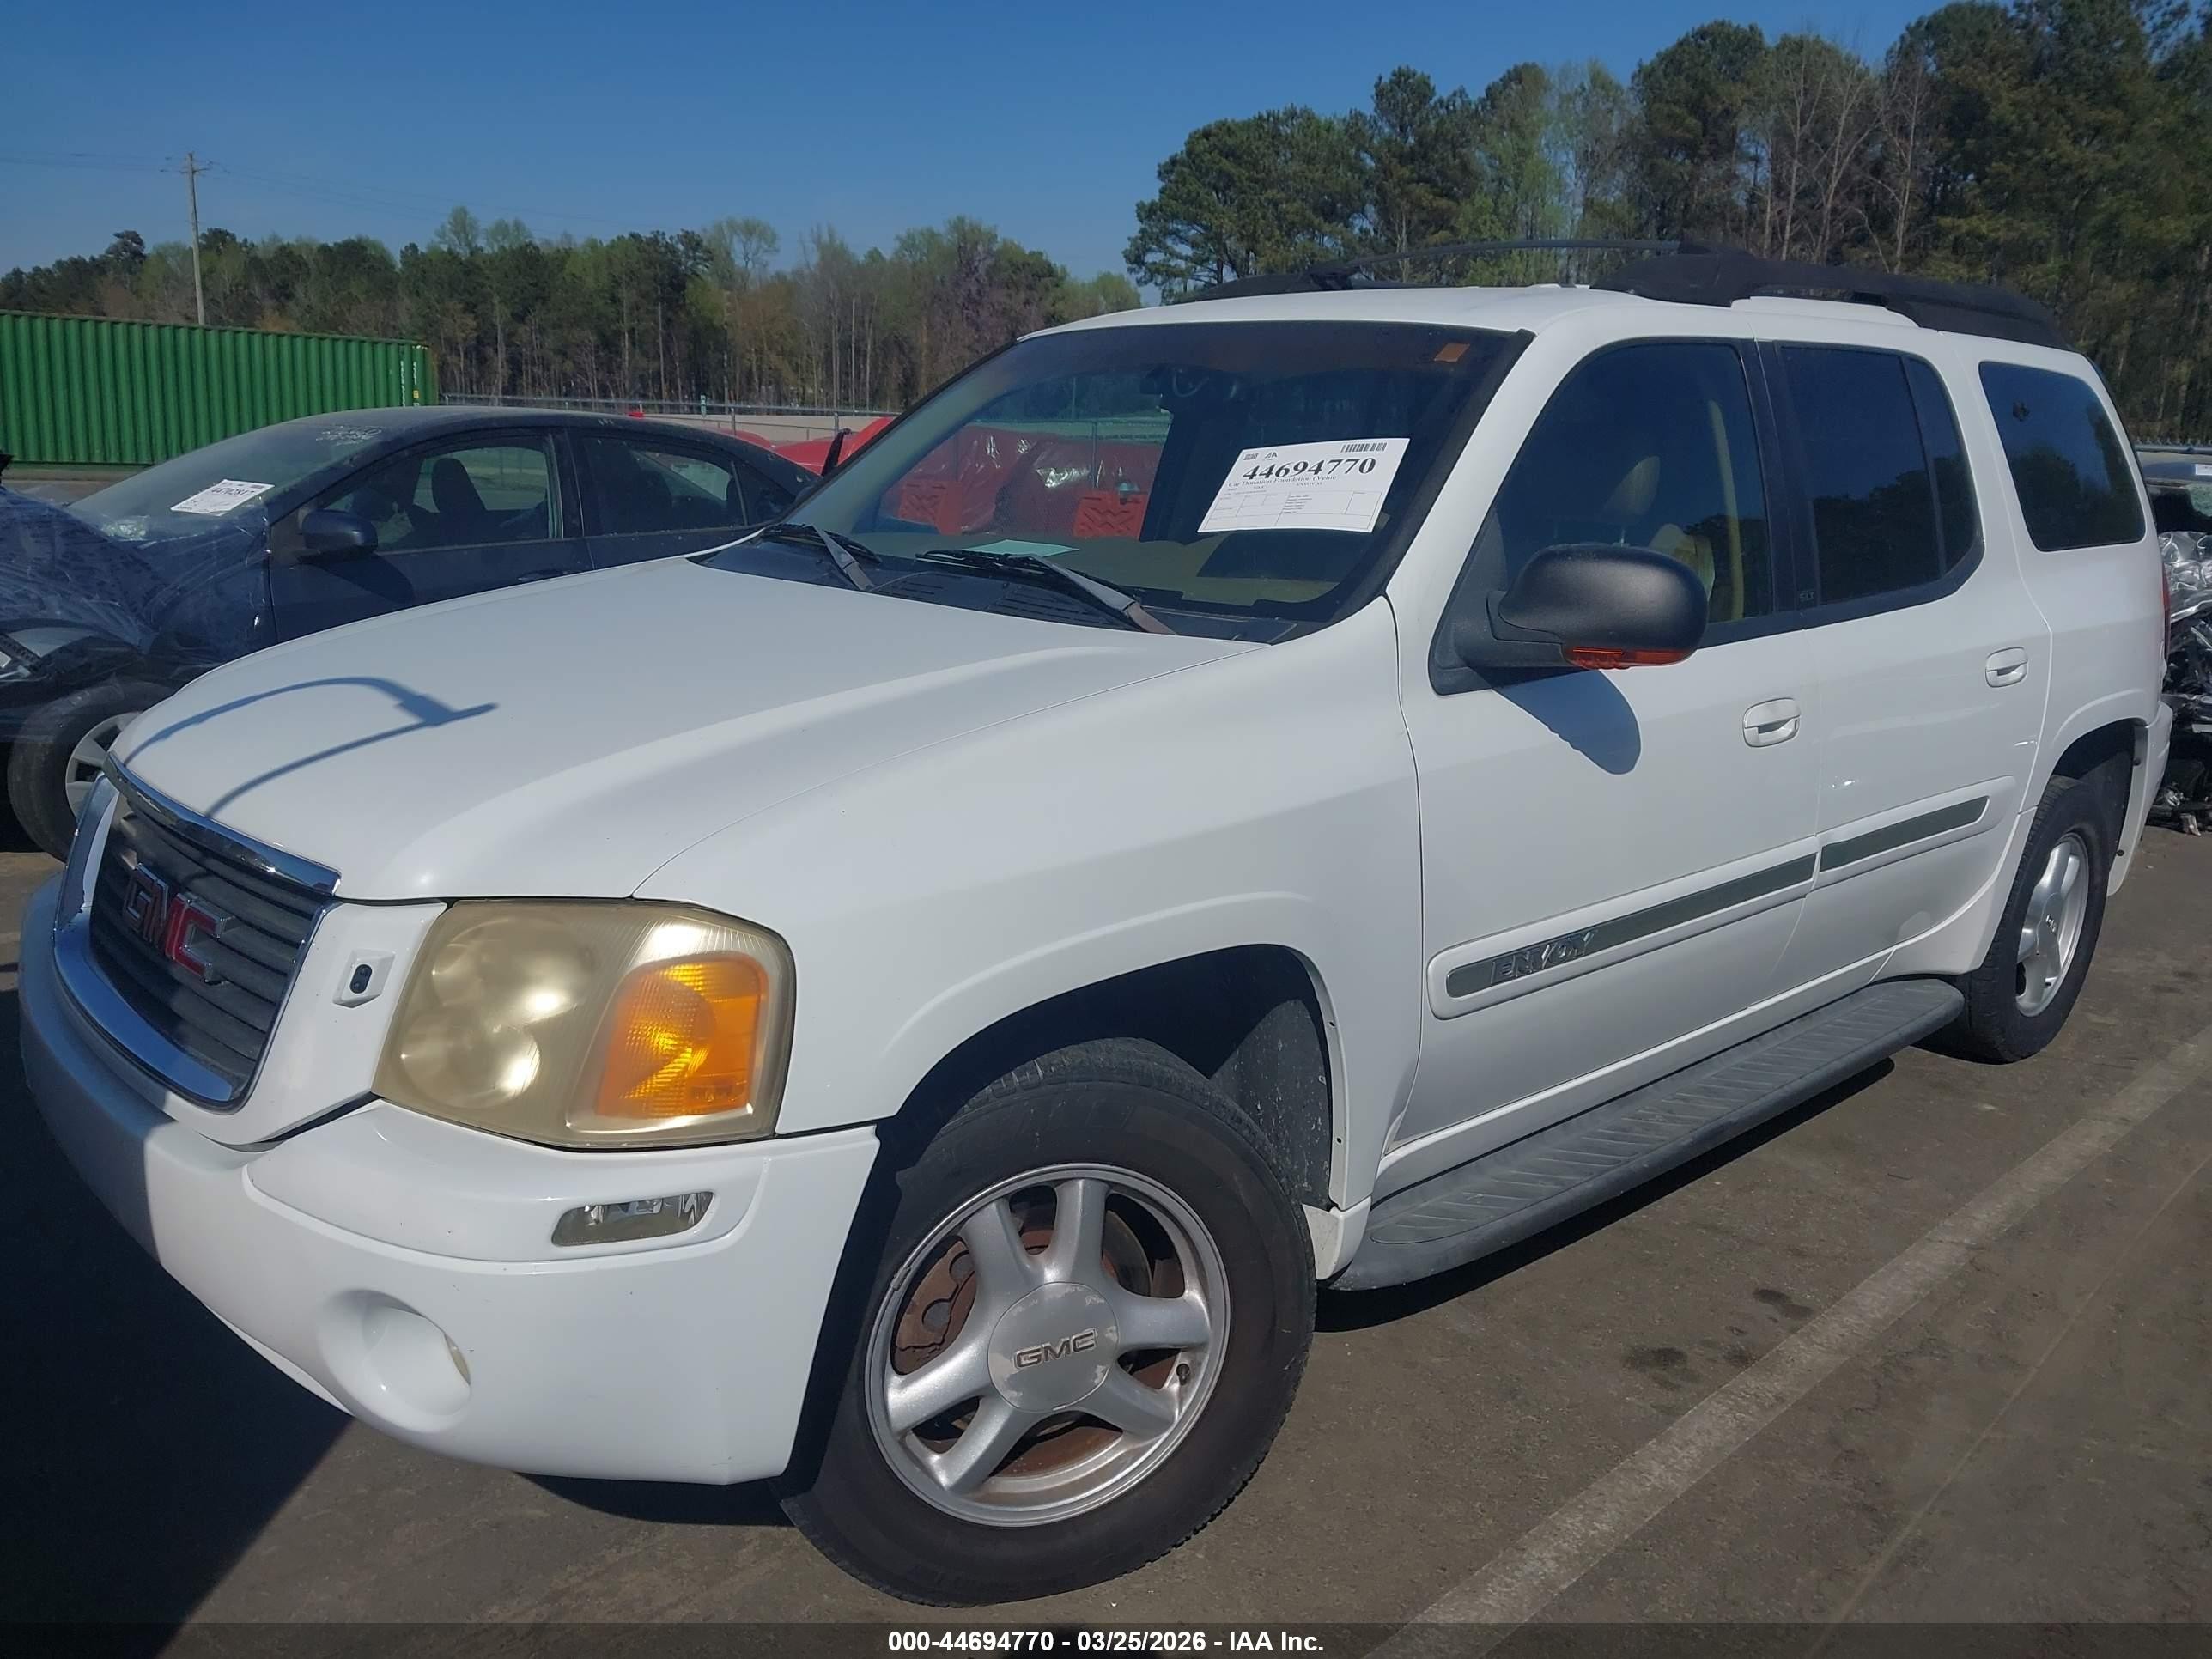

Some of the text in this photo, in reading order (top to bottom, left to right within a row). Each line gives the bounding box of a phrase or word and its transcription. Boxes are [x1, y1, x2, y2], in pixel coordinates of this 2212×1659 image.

[1243, 457, 1377, 481] 44694770
[124, 861, 225, 983] GMC
[1490, 929, 1598, 985] ENVOY
[1012, 1328, 1097, 1370] GMC
